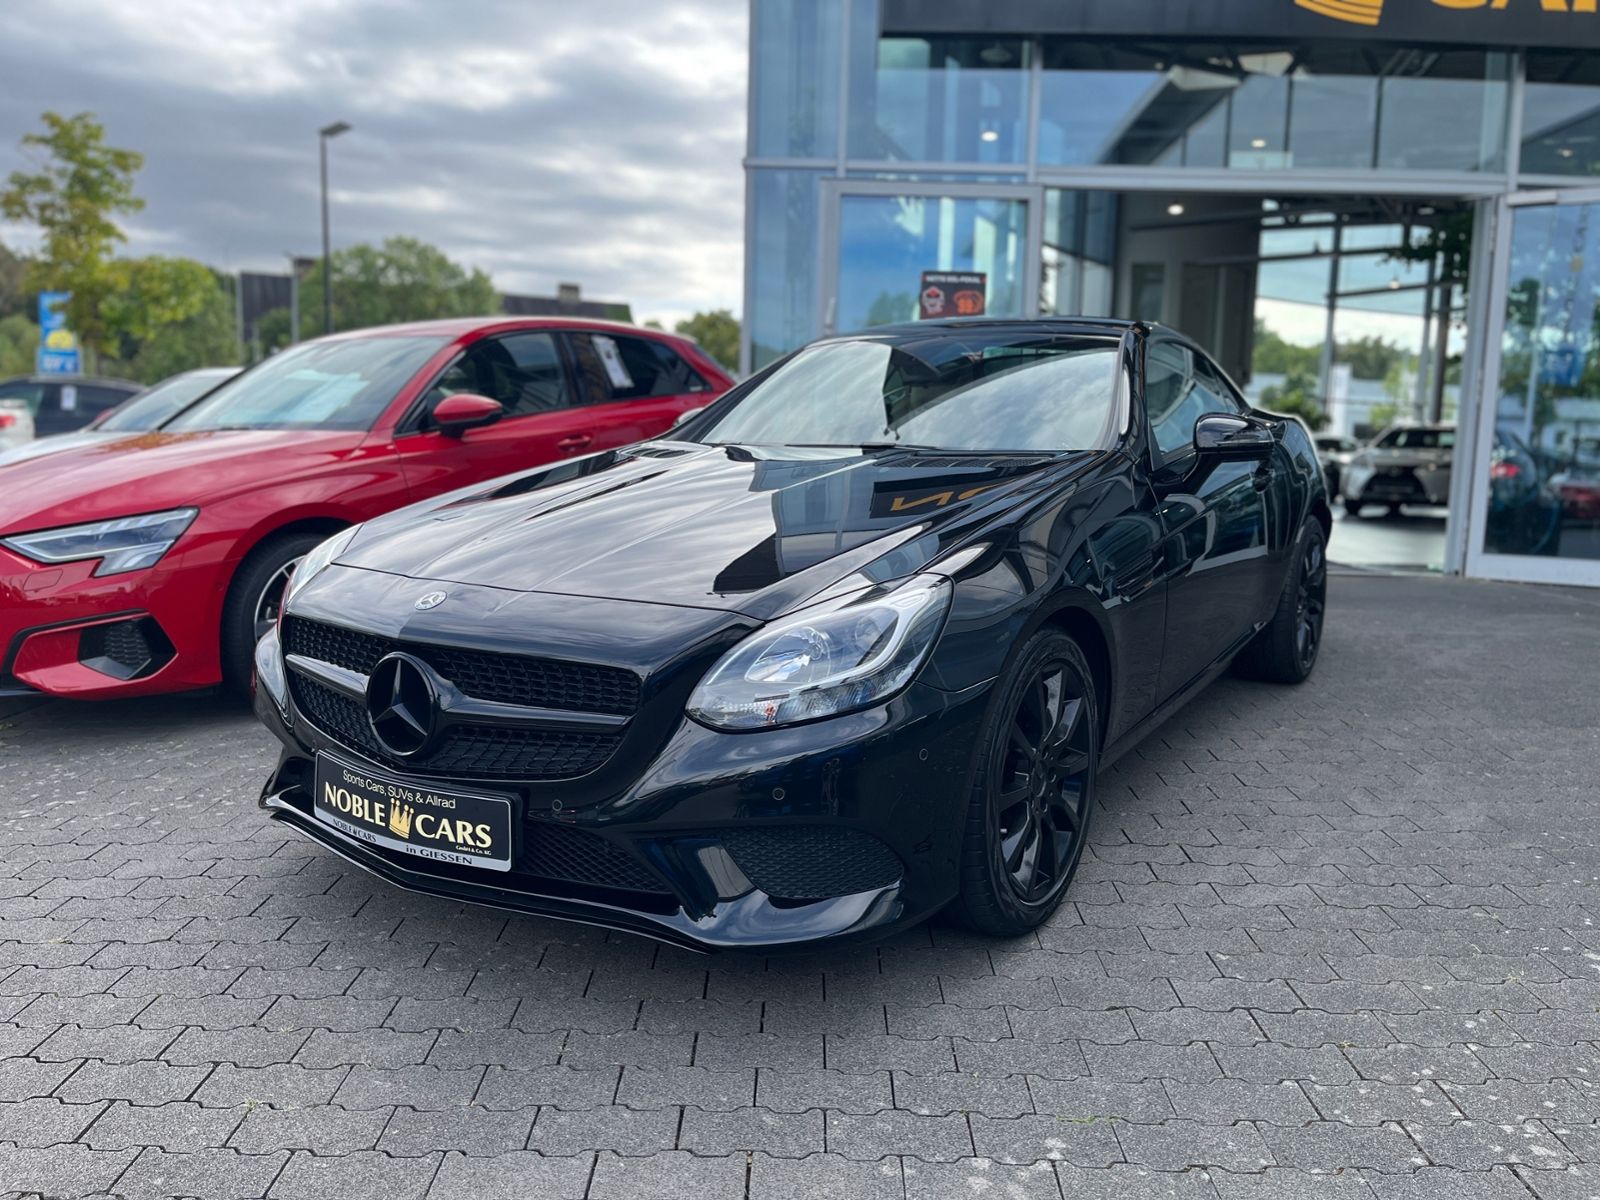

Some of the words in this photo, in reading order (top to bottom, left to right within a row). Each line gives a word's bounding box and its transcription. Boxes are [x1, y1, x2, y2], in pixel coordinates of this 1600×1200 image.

[343, 769, 365, 787] Sports
[365, 779, 387, 797] Cars,
[388, 785, 414, 802] SUVs
[415, 792, 424, 804] &
[425, 794, 456, 809] Allrad
[324, 781, 386, 827] NOBLE
[415, 814, 492, 848] CARS
[333, 818, 352, 833] NOBLE
[358, 830, 377, 843] CARS
[406, 845, 416, 855] in
[420, 848, 473, 865] GIESSEN
